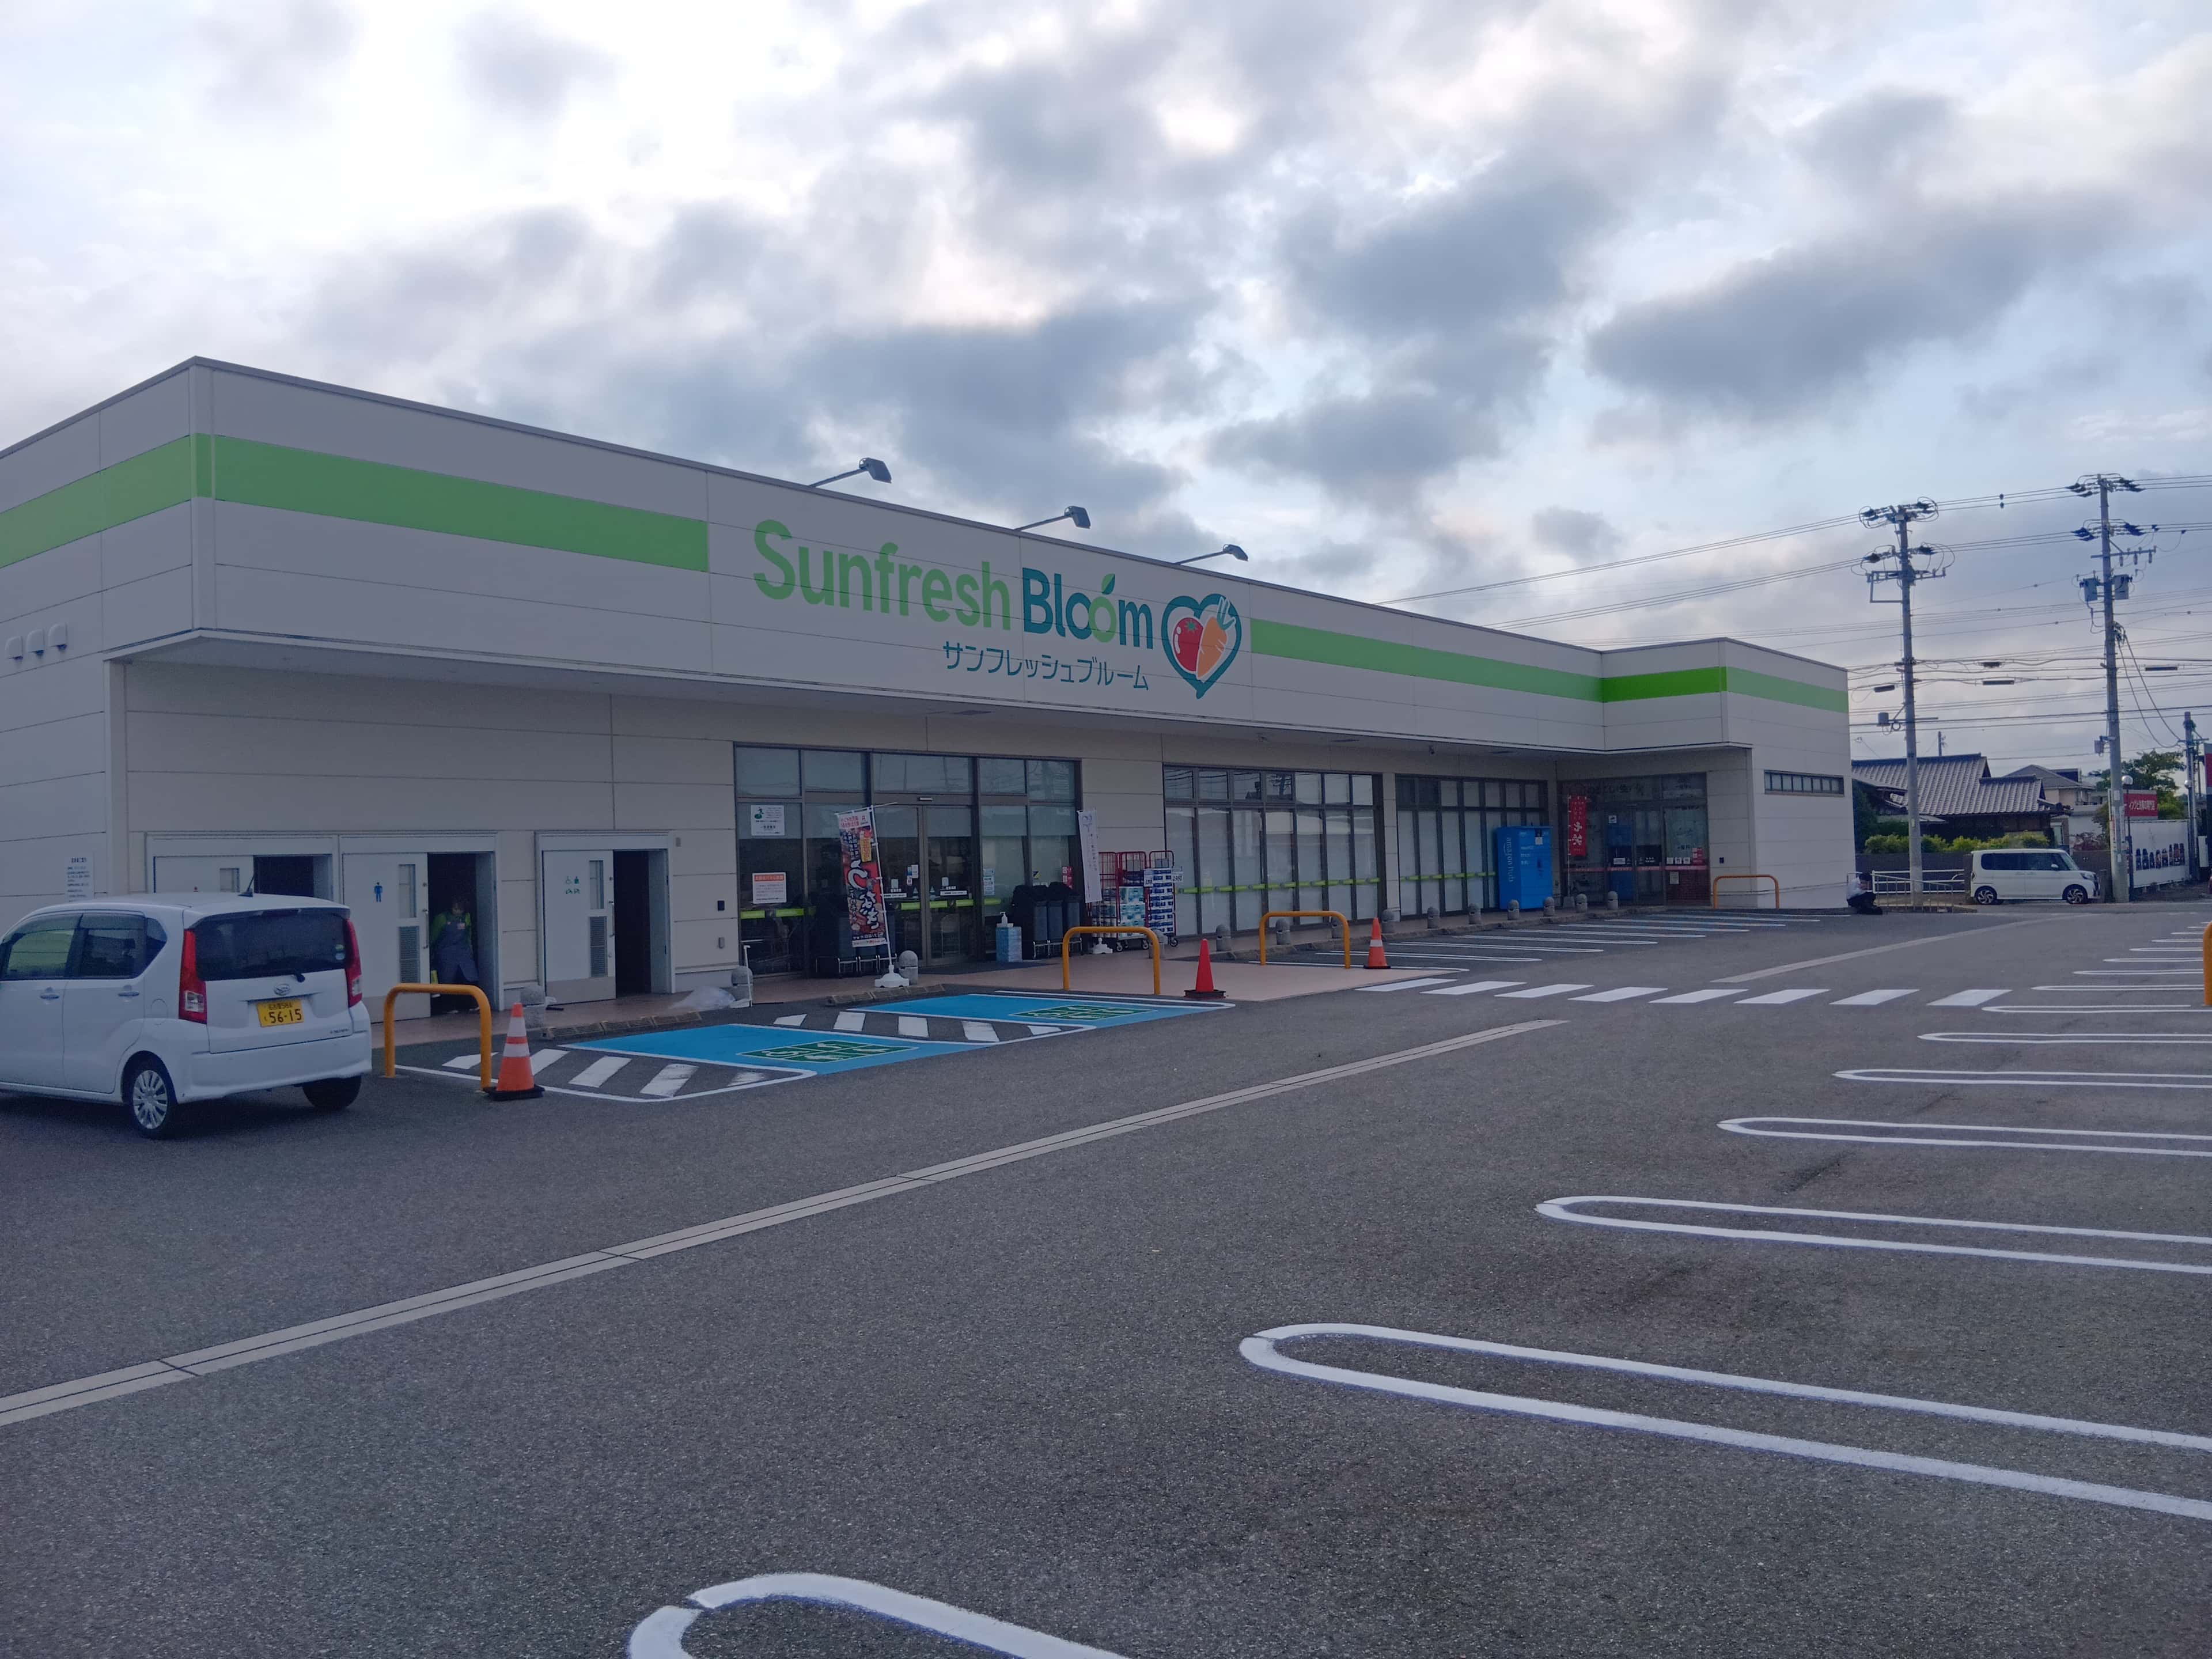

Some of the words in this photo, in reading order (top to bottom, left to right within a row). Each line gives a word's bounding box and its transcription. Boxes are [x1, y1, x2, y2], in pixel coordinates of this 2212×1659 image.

[753, 518, 1012, 631] Sunfresh
[1022, 567, 1154, 650] Bloom
[942, 640, 1149, 691] サンフレッシュブルーム
[268, 1009, 302, 1024] 56-15
